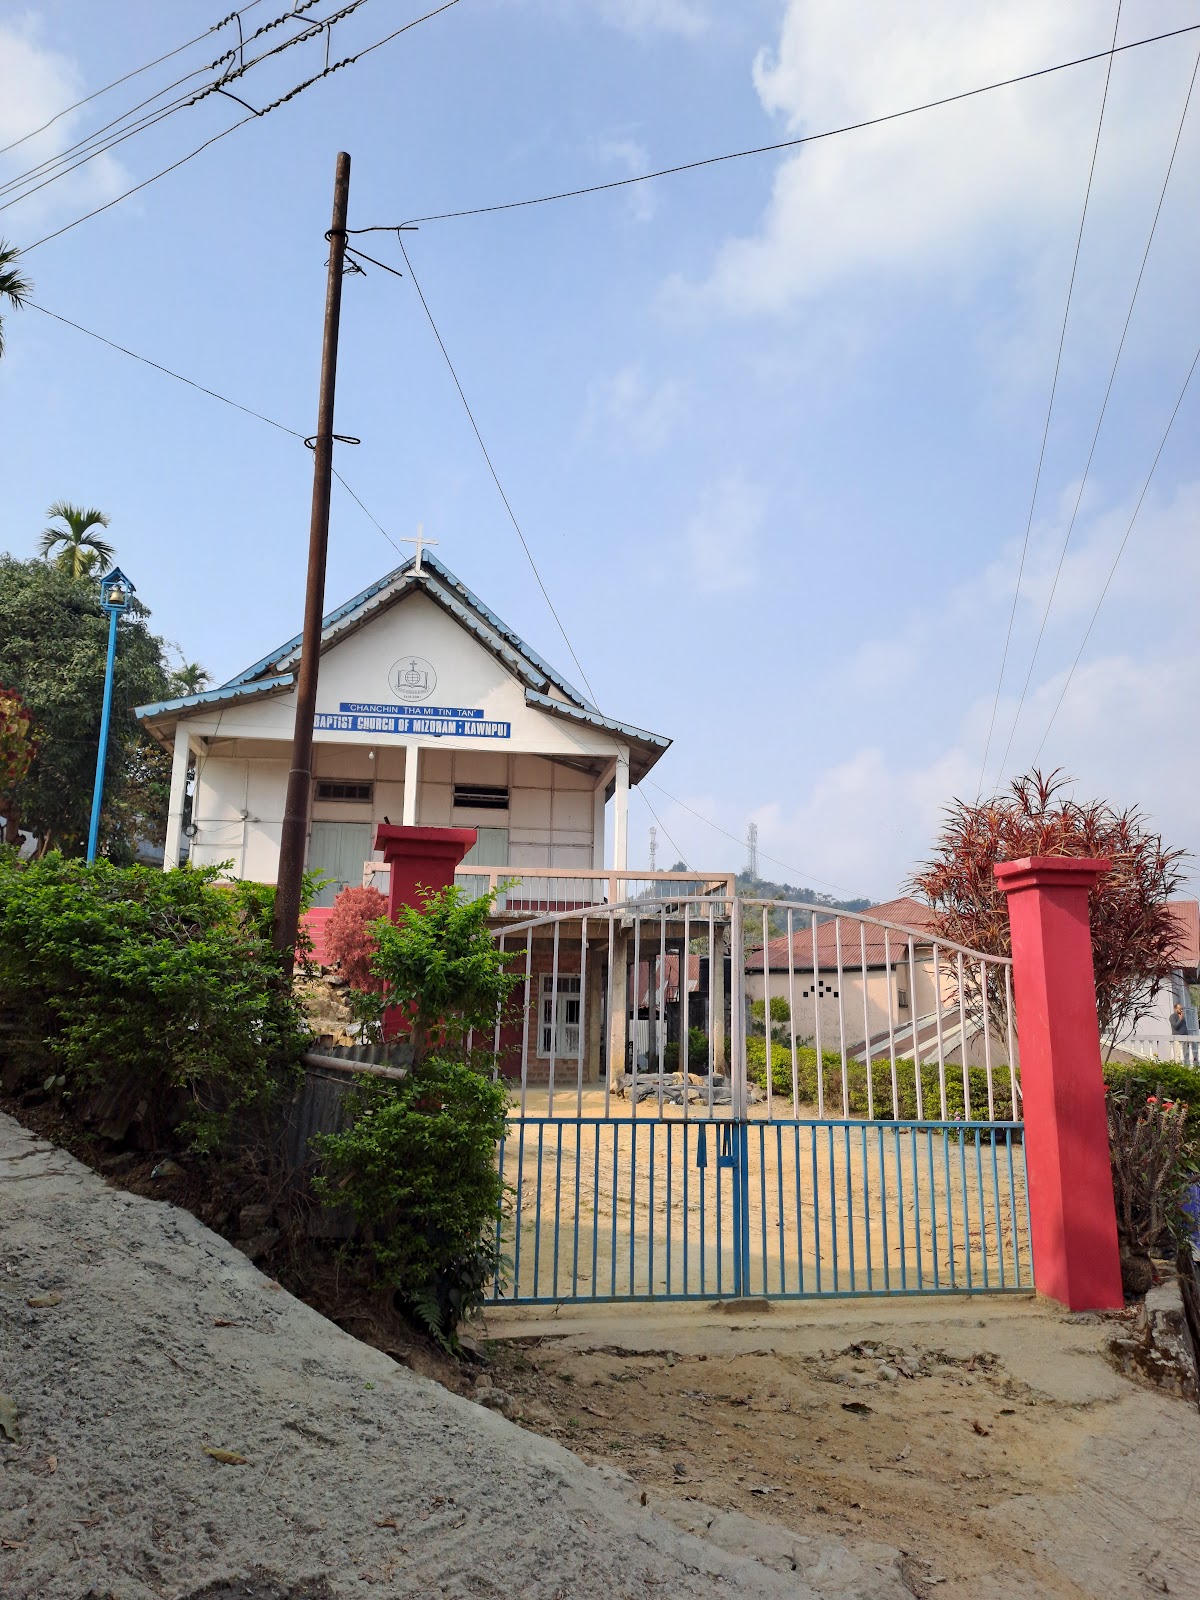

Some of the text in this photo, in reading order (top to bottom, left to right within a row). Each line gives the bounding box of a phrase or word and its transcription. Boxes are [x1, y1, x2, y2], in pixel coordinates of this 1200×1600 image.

[437, 708, 452, 716] TIN
[313, 714, 353, 729] BAPTIST
[357, 716, 394, 731] CHURCH
[397, 718, 410, 732] OF
[412, 719, 456, 734] MIZORAM
[464, 721, 507, 737] KAWNPUI
